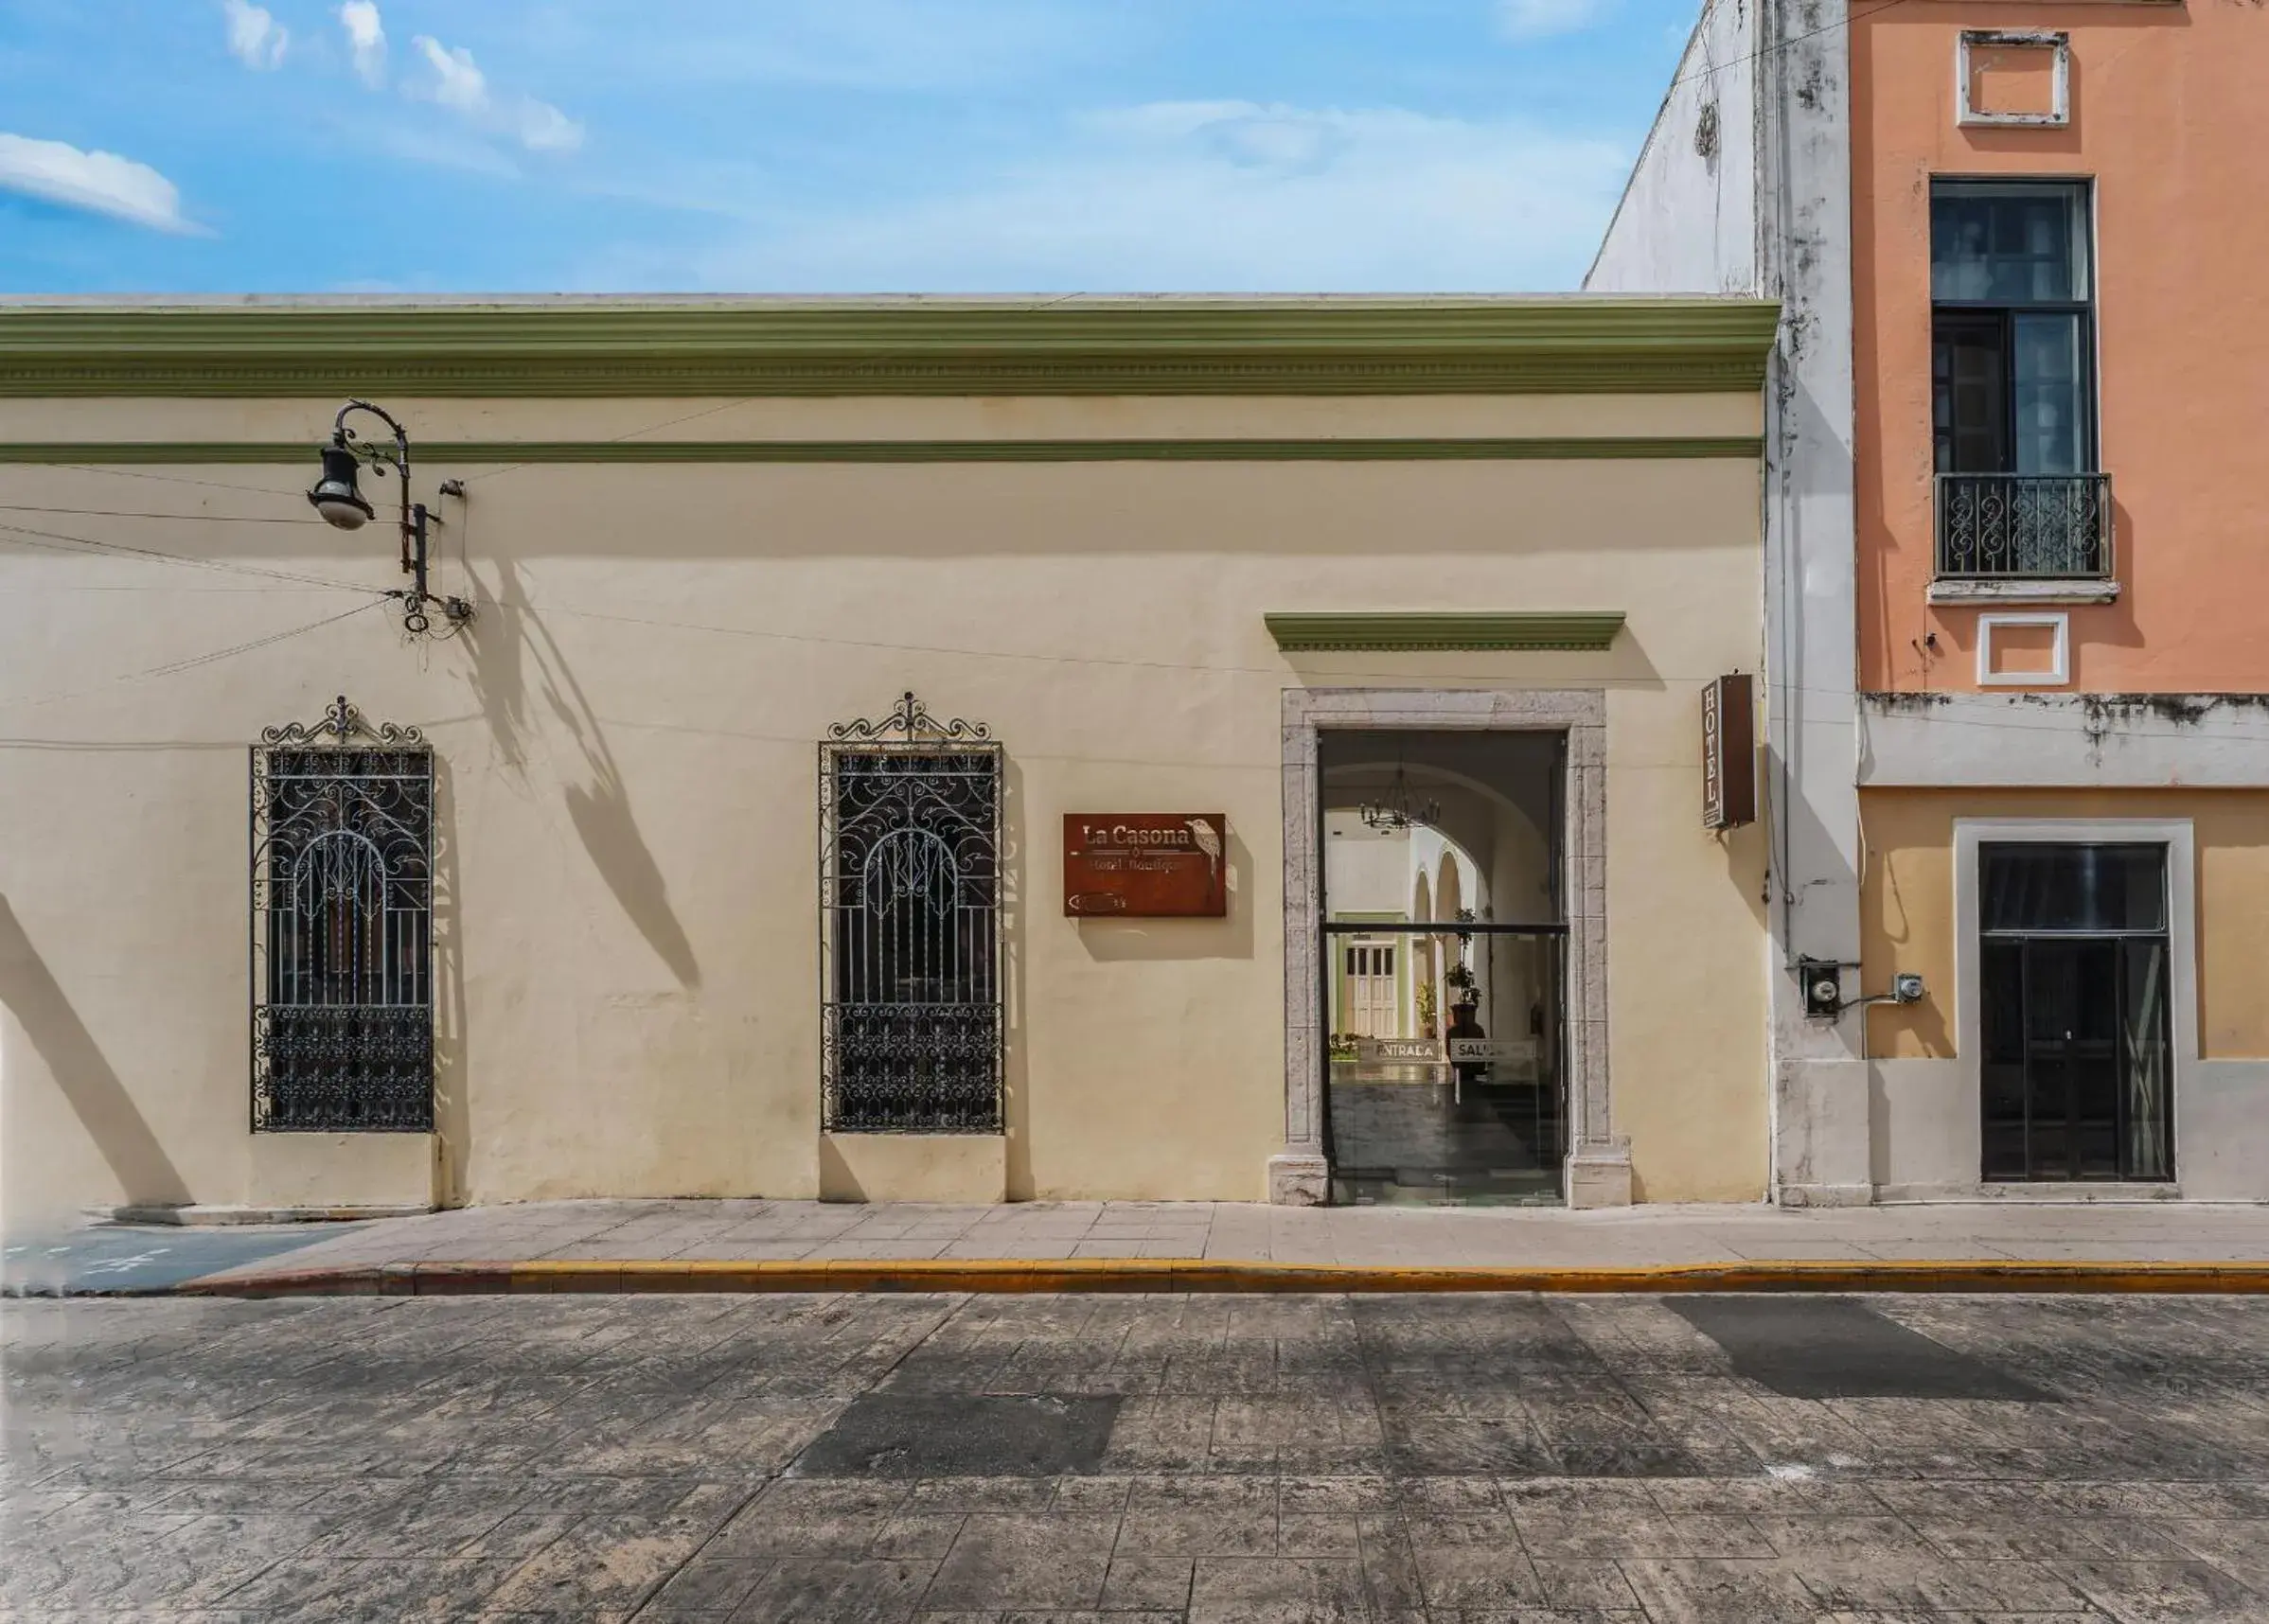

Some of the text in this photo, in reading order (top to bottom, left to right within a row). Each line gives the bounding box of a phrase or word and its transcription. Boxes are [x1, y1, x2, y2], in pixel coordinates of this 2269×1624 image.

[1705, 687, 1717, 803] HOTEL
[1083, 825, 1189, 844] La Casona
[1377, 1044, 1433, 1056] ENTRADA
